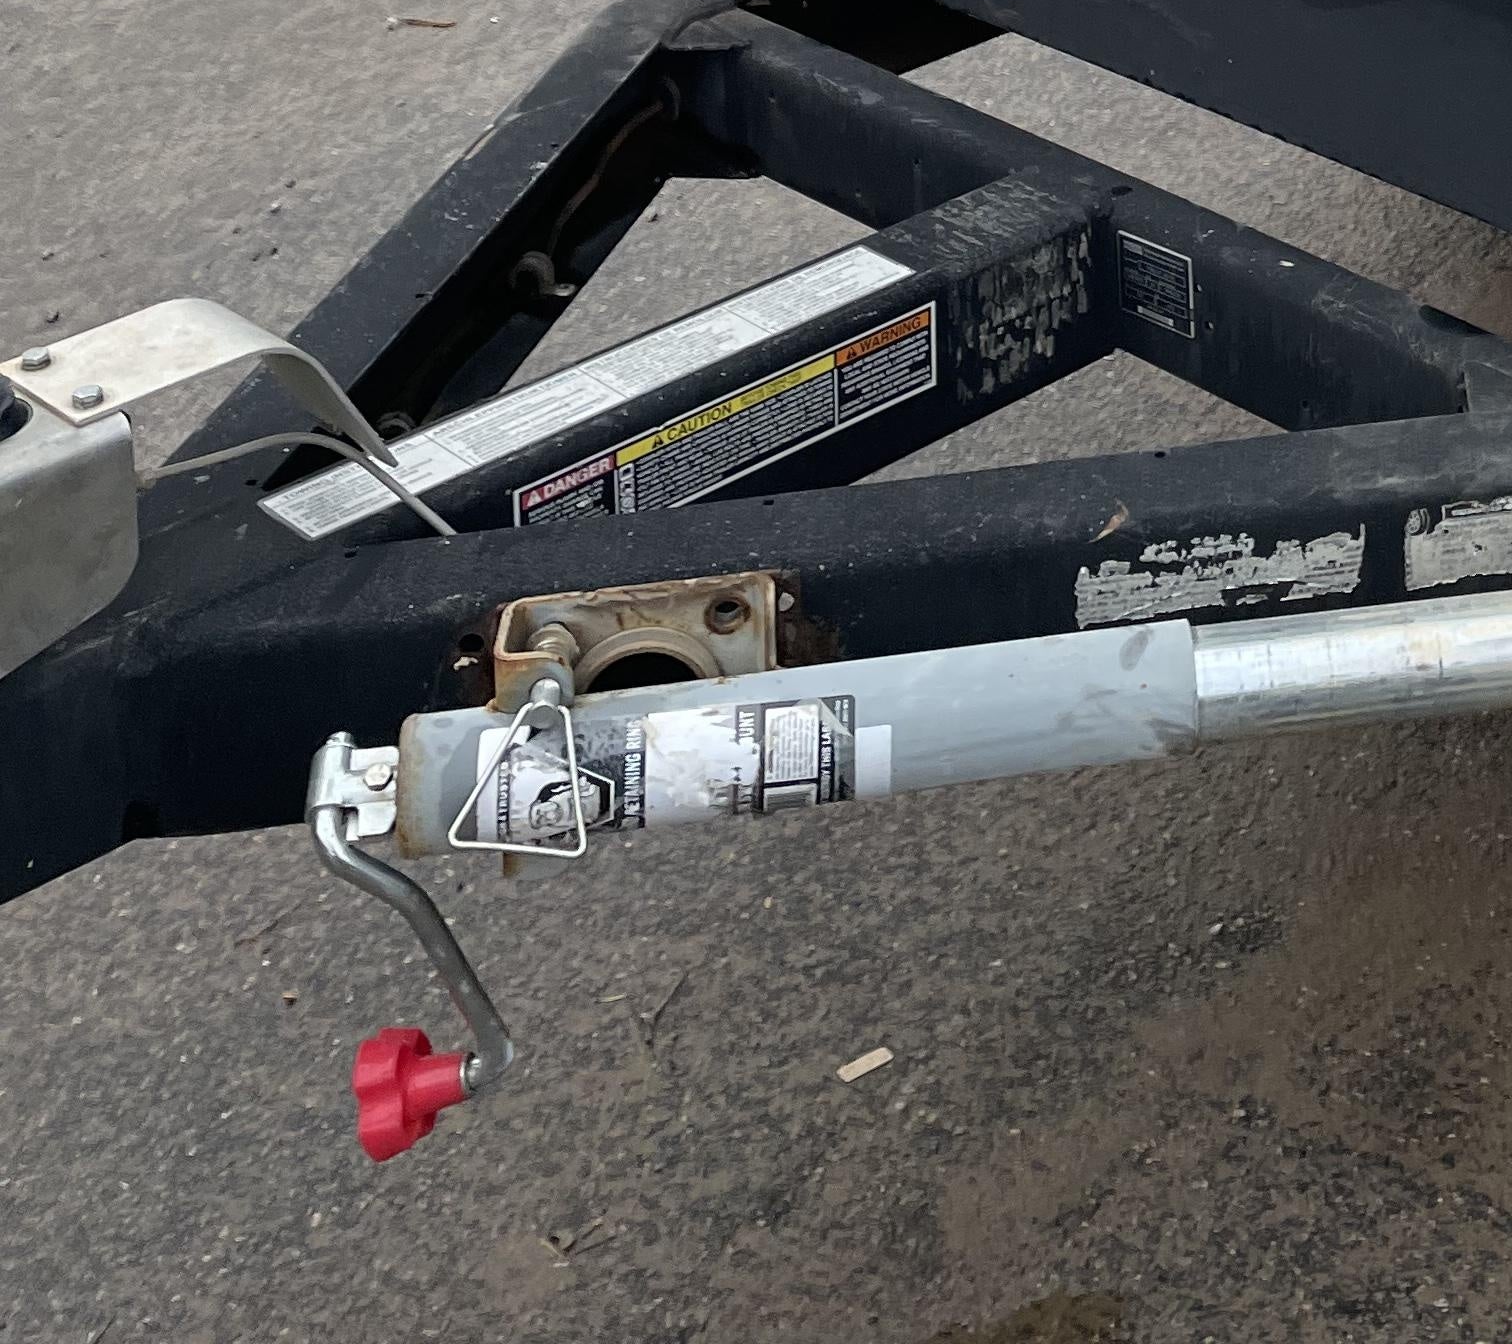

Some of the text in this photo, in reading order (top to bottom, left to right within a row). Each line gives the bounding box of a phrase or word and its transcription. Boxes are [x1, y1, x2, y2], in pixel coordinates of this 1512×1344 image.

[860, 316, 921, 353] WARNING
[667, 402, 732, 441] CAUTION
[543, 457, 610, 498] DANGER
